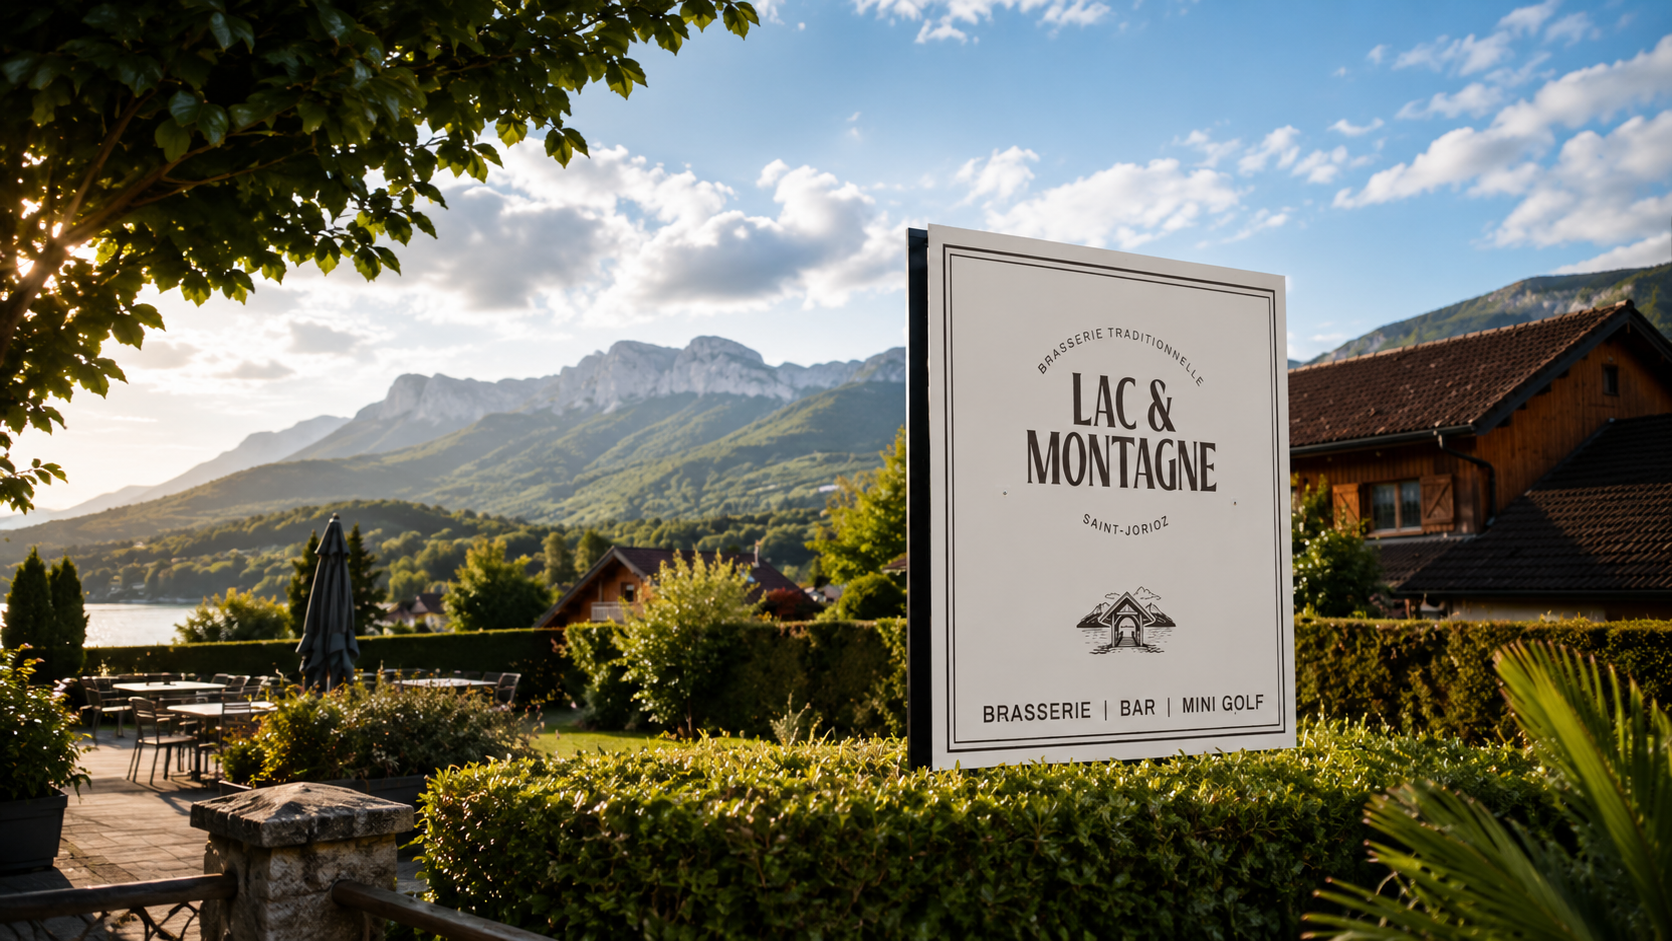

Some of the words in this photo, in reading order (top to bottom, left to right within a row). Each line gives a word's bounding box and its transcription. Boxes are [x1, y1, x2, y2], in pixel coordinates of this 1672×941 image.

[1037, 328, 1103, 375] BRASSERIE
[1107, 327, 1204, 387] TRADITIONNELLE
[1071, 372, 1137, 431] LAC
[1147, 378, 1177, 433] &
[1026, 429, 1218, 493] MONTAGNE
[1082, 513, 1169, 536] SAINT-JORIOZ
[983, 702, 1091, 724] BRASSERIE
[1120, 699, 1156, 717] BAR
[1182, 696, 1216, 714] MINI
[1221, 693, 1264, 712] GOLF
